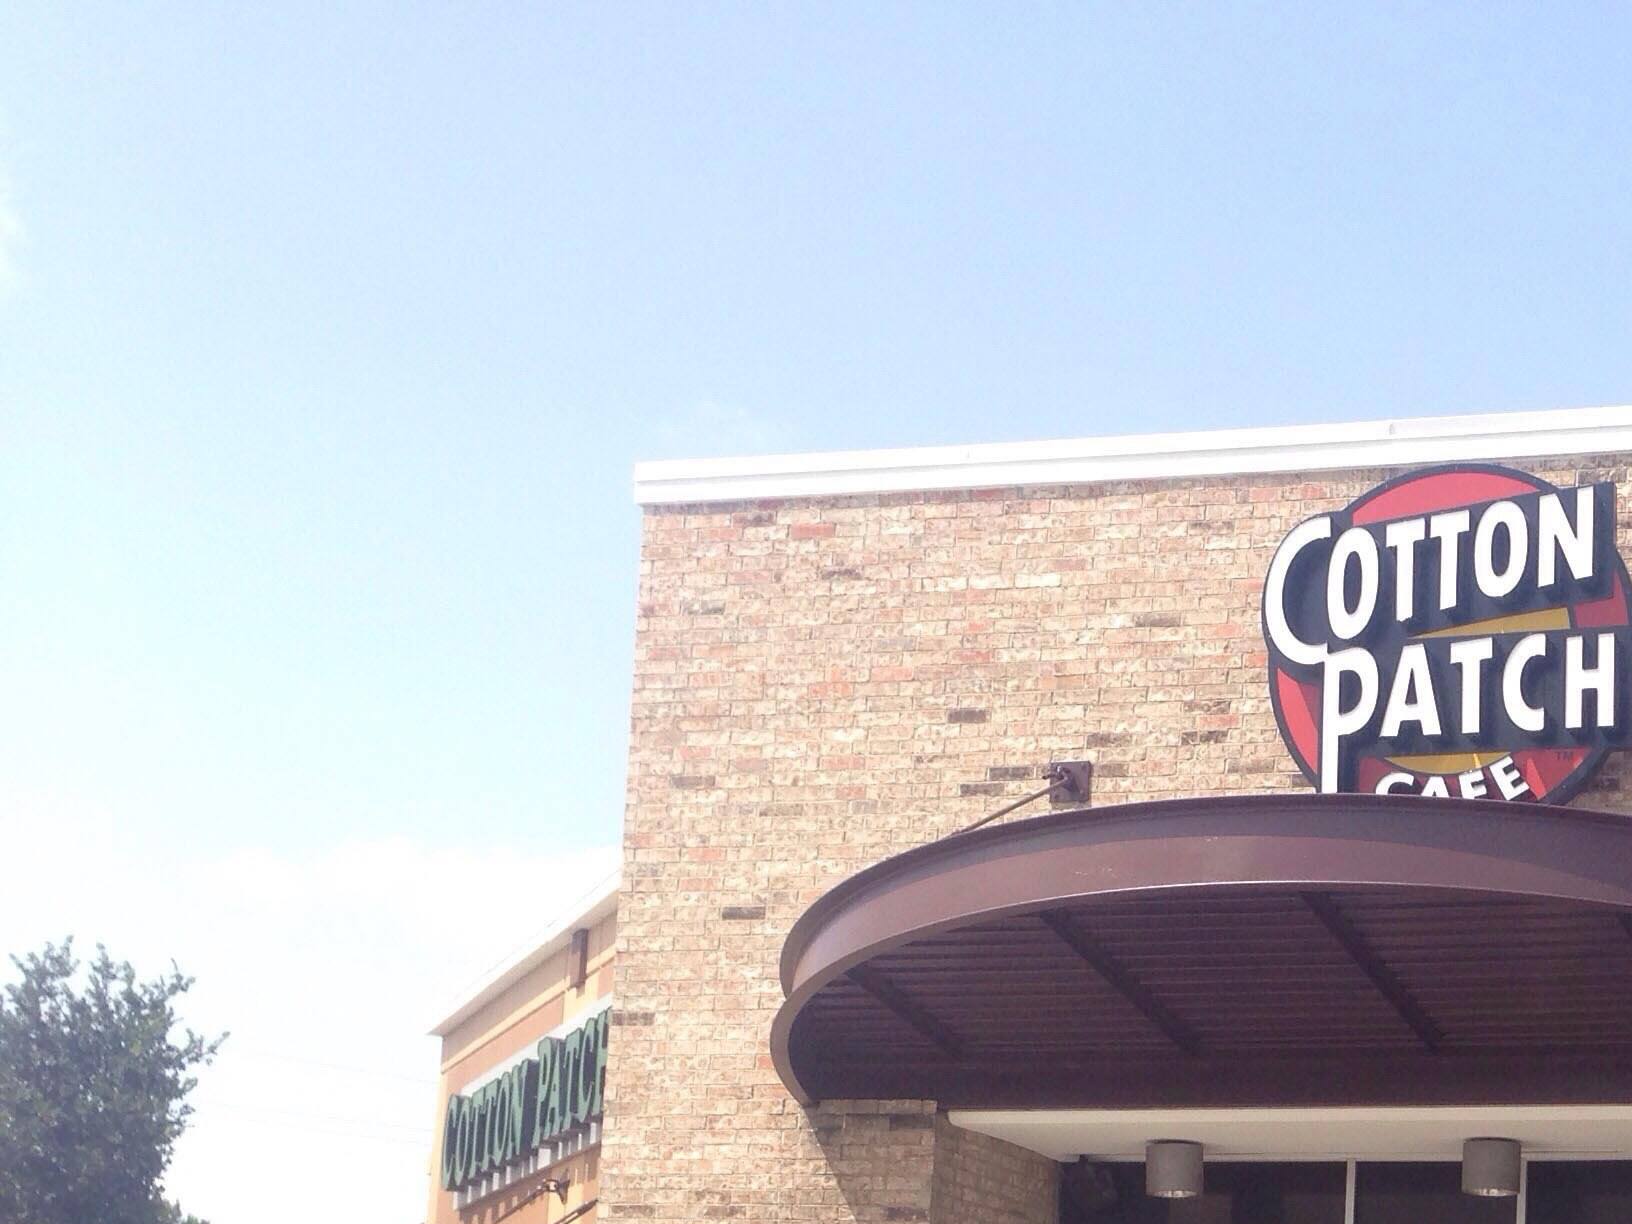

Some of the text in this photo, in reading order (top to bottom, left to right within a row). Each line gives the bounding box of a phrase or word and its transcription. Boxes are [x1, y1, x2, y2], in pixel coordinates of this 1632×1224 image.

[1265, 485, 1594, 664] COTTON
[1321, 632, 1615, 794] PATCH
[442, 1057, 535, 1190] COTTON
